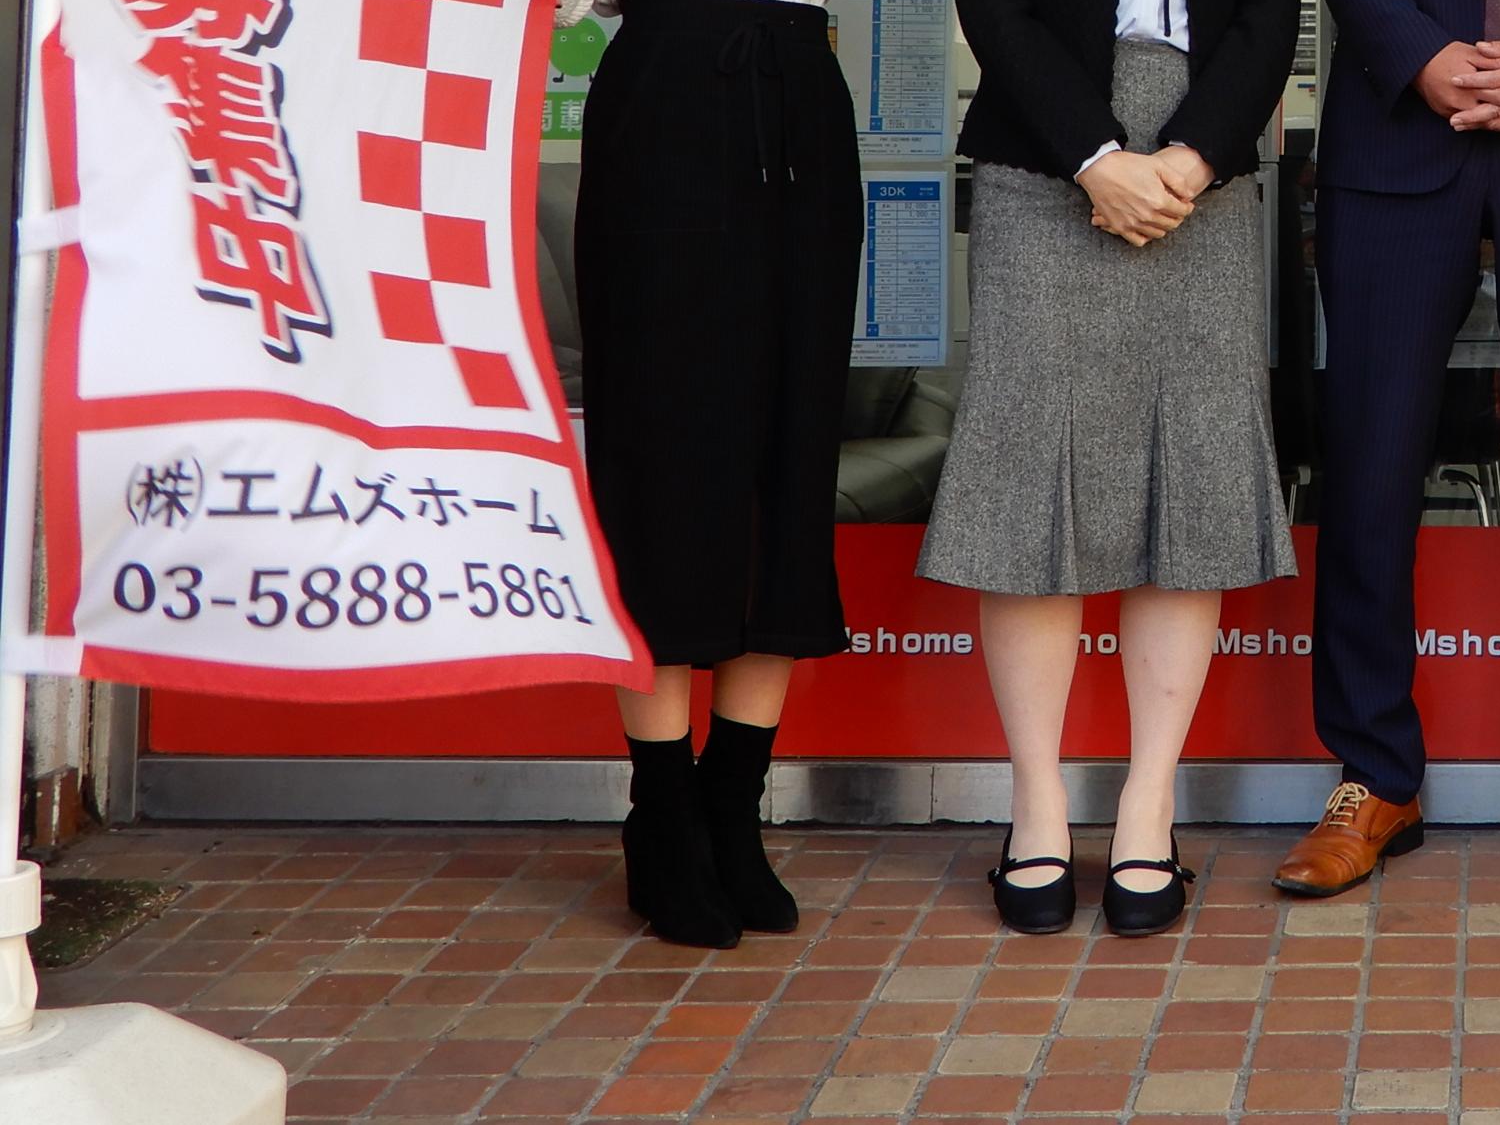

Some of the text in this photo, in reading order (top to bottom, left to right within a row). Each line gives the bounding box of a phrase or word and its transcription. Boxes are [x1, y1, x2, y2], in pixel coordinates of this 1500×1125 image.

[879, 186, 907, 197] 3DK
[113, 561, 595, 631] 03-5888-5861
[843, 627, 973, 654] shome
[1212, 628, 1313, 655] Msho
